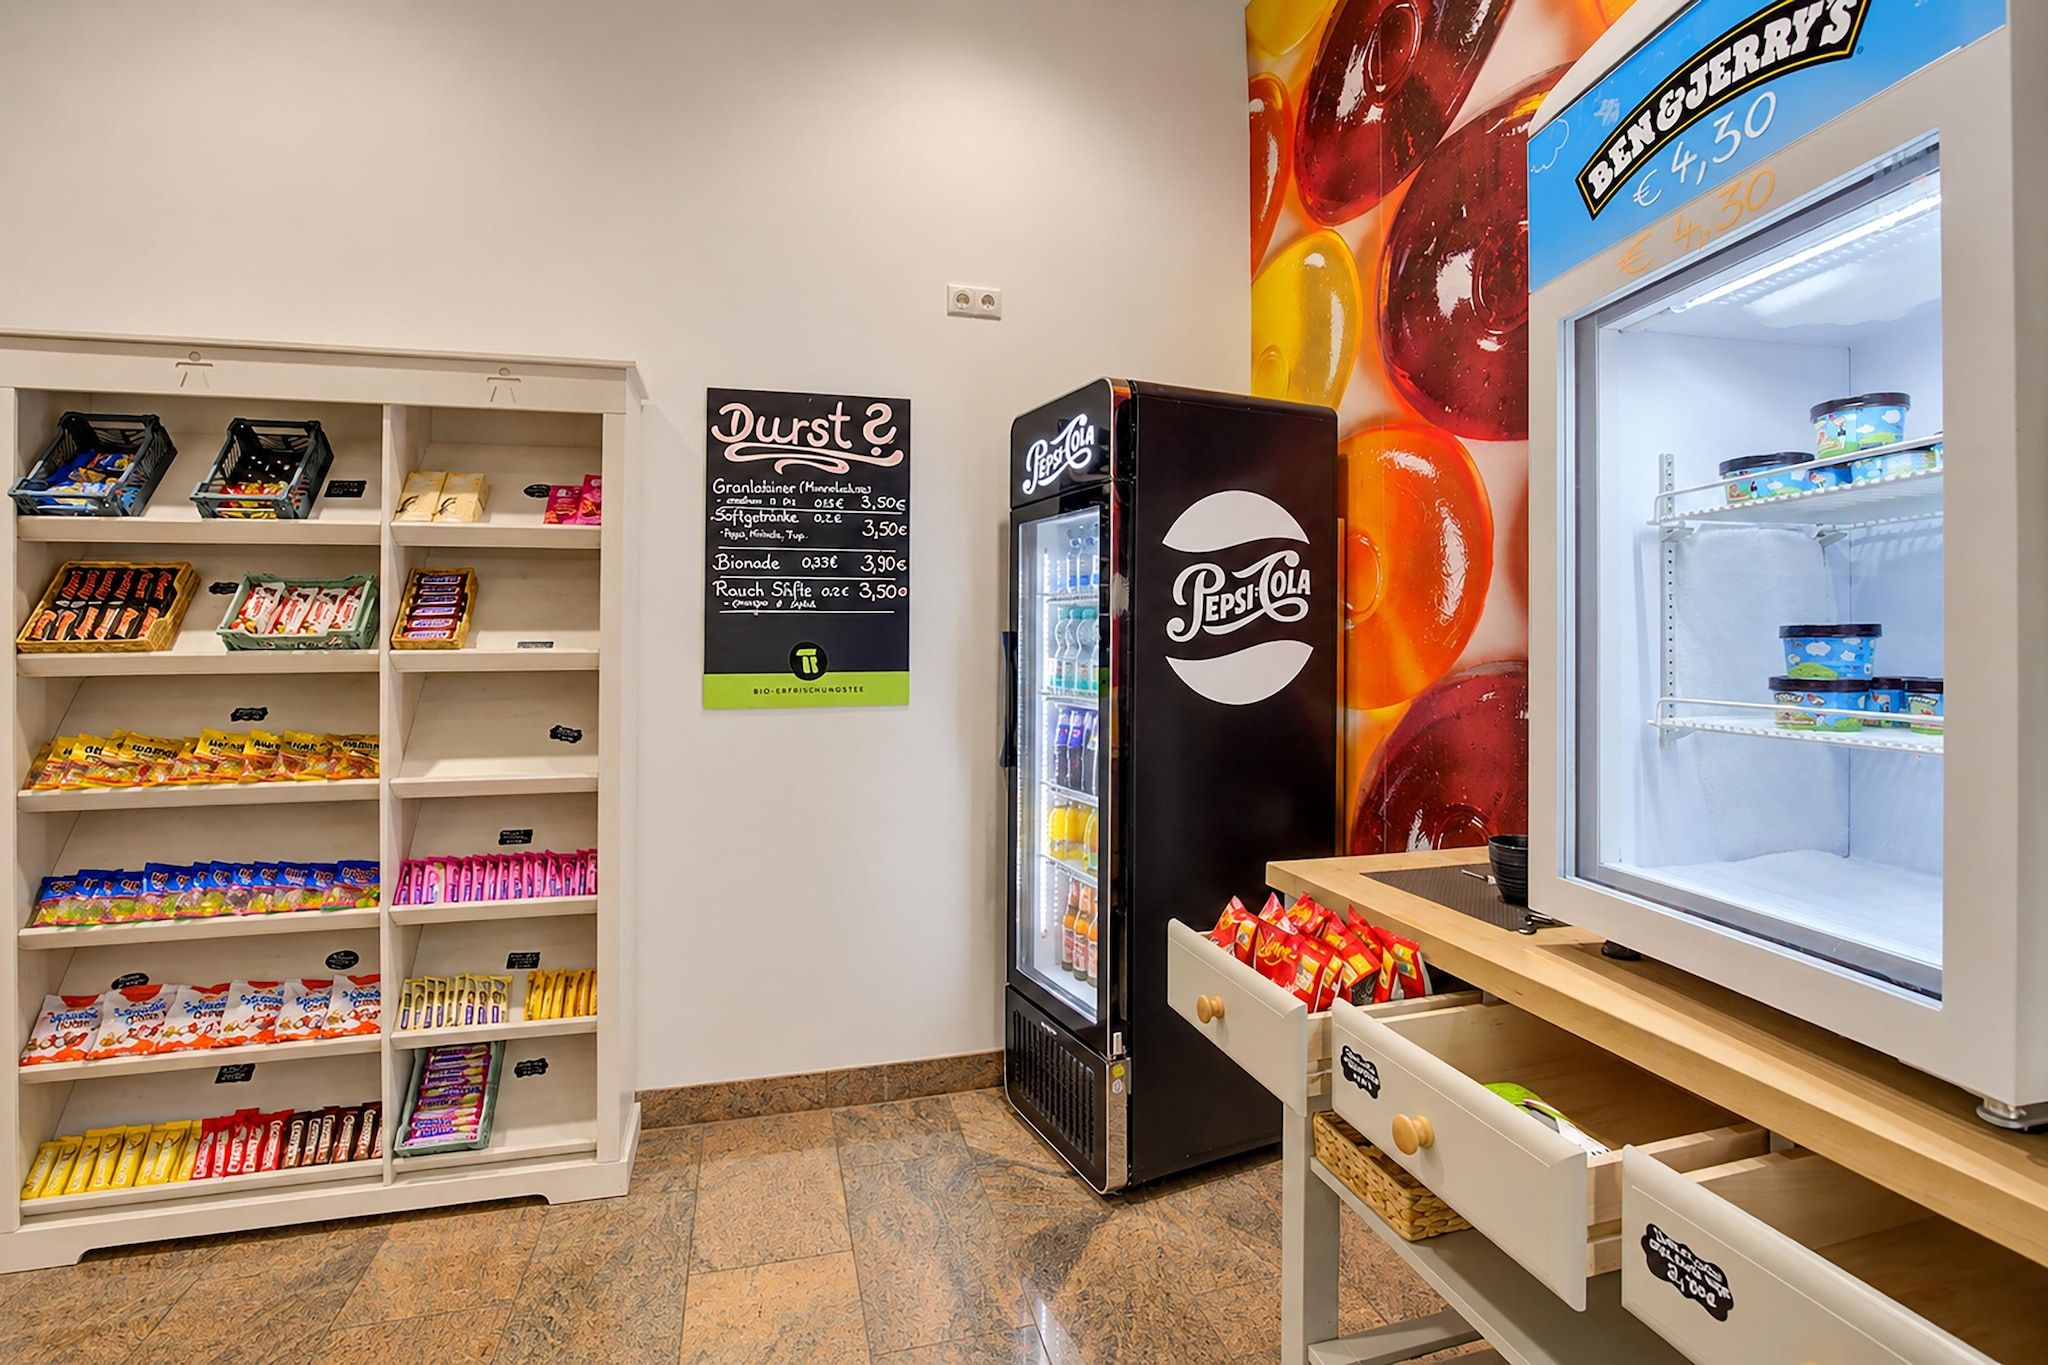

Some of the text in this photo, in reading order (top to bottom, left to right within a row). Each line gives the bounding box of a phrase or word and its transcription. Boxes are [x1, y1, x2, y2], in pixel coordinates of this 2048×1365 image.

[1588, 110, 1655, 199] BEN
[1656, 87, 1686, 131] &
[1671, 91, 1776, 185] 4,30
[711, 401, 852, 449] Durst
[712, 553, 780, 571] Bionade
[712, 580, 765, 597] Rauch
